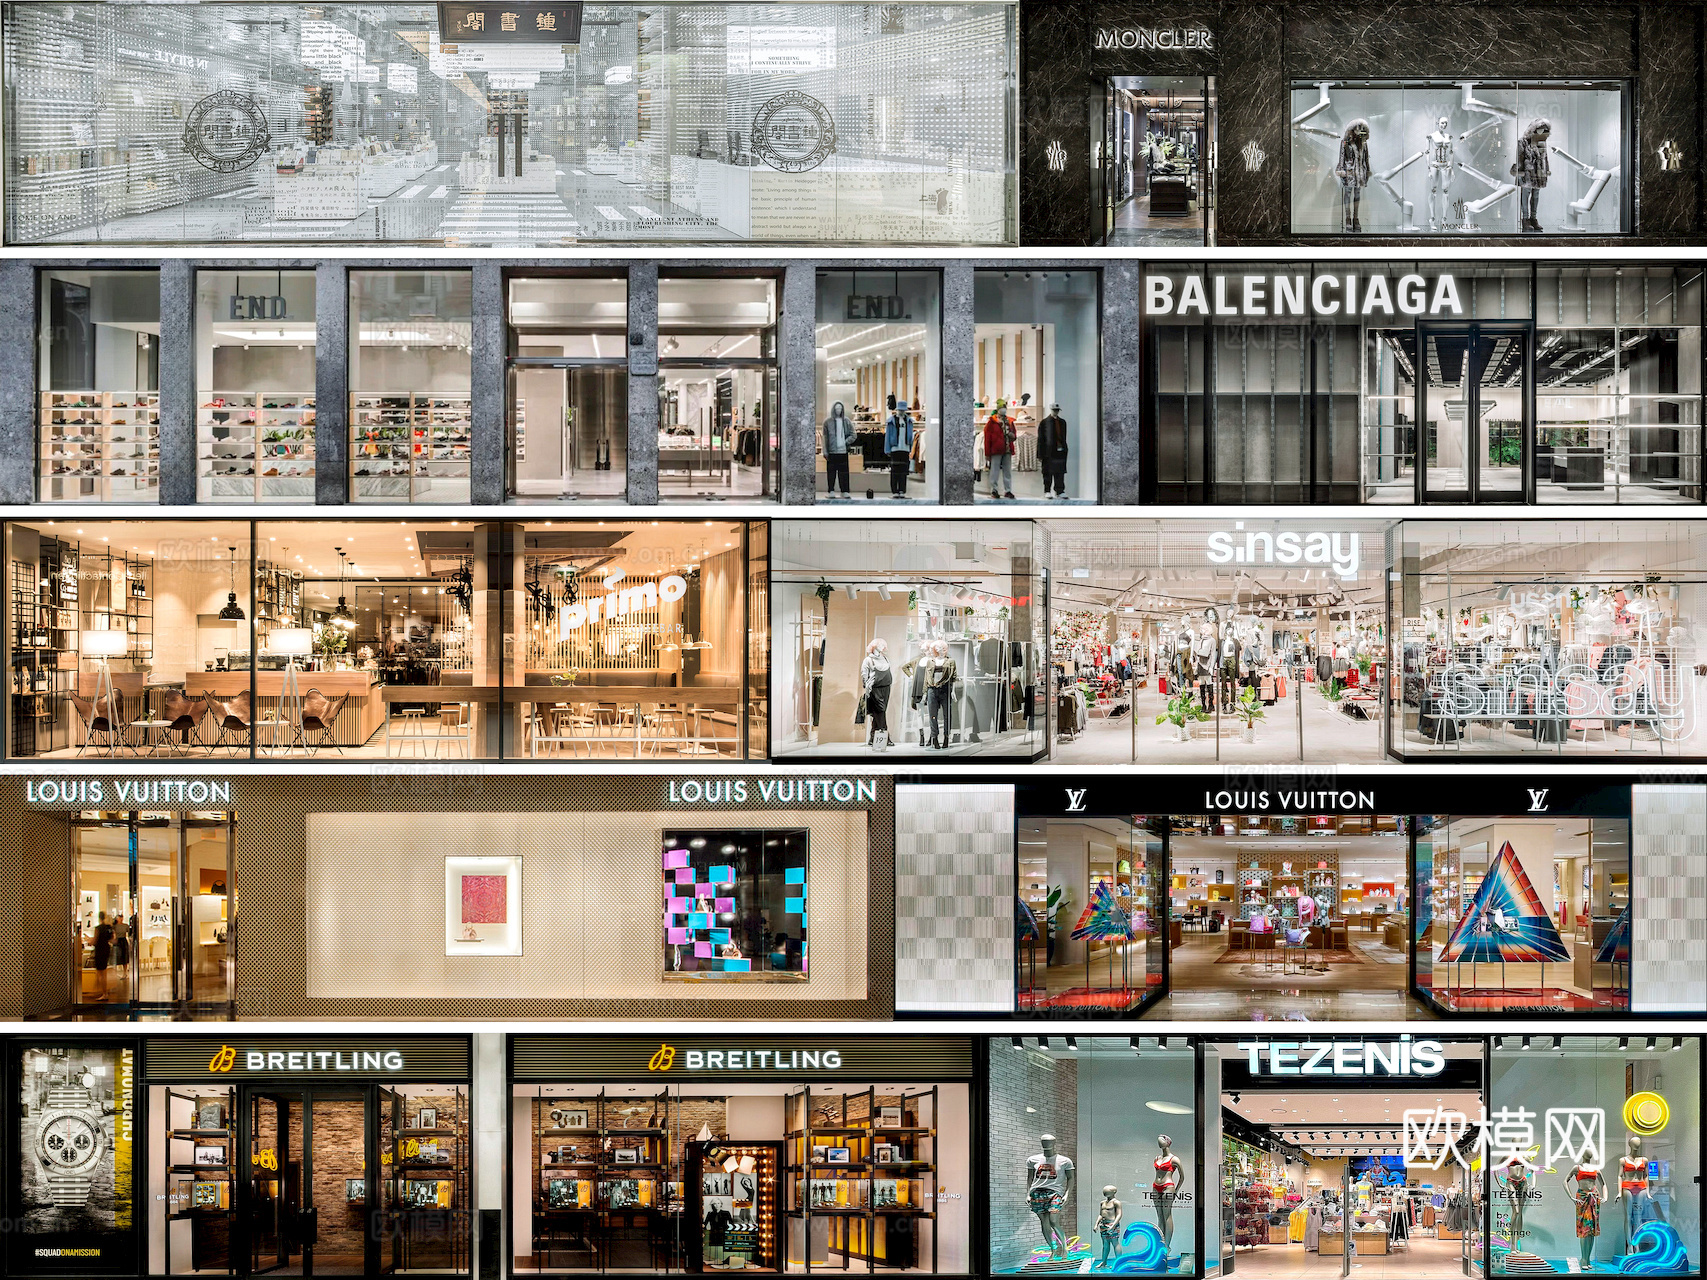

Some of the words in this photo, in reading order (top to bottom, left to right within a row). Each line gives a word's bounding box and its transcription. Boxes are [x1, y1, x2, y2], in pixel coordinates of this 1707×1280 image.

[1095, 28, 1213, 49] MONCLER
[1146, 275, 1463, 315] BALENCIAGA
[847, 294, 912, 320] END.
[1208, 521, 1359, 576] sinsay
[560, 566, 687, 642] primo
[26, 780, 103, 803] LOUIS
[118, 780, 231, 803] VUITTON
[669, 780, 747, 803] LOUIS
[758, 779, 877, 803] VUITTON
[1205, 791, 1270, 809] LOUIS
[1278, 791, 1375, 809] VUITTON
[247, 1052, 403, 1070] BREITLING
[686, 1051, 842, 1069] BREITLING
[121, 1048, 133, 1141] CHRONOMAT
[1496, 1211, 1509, 1219] be
[1496, 1229, 1531, 1238] change
[35, 1248, 101, 1257] #SQUADONAMISSION
